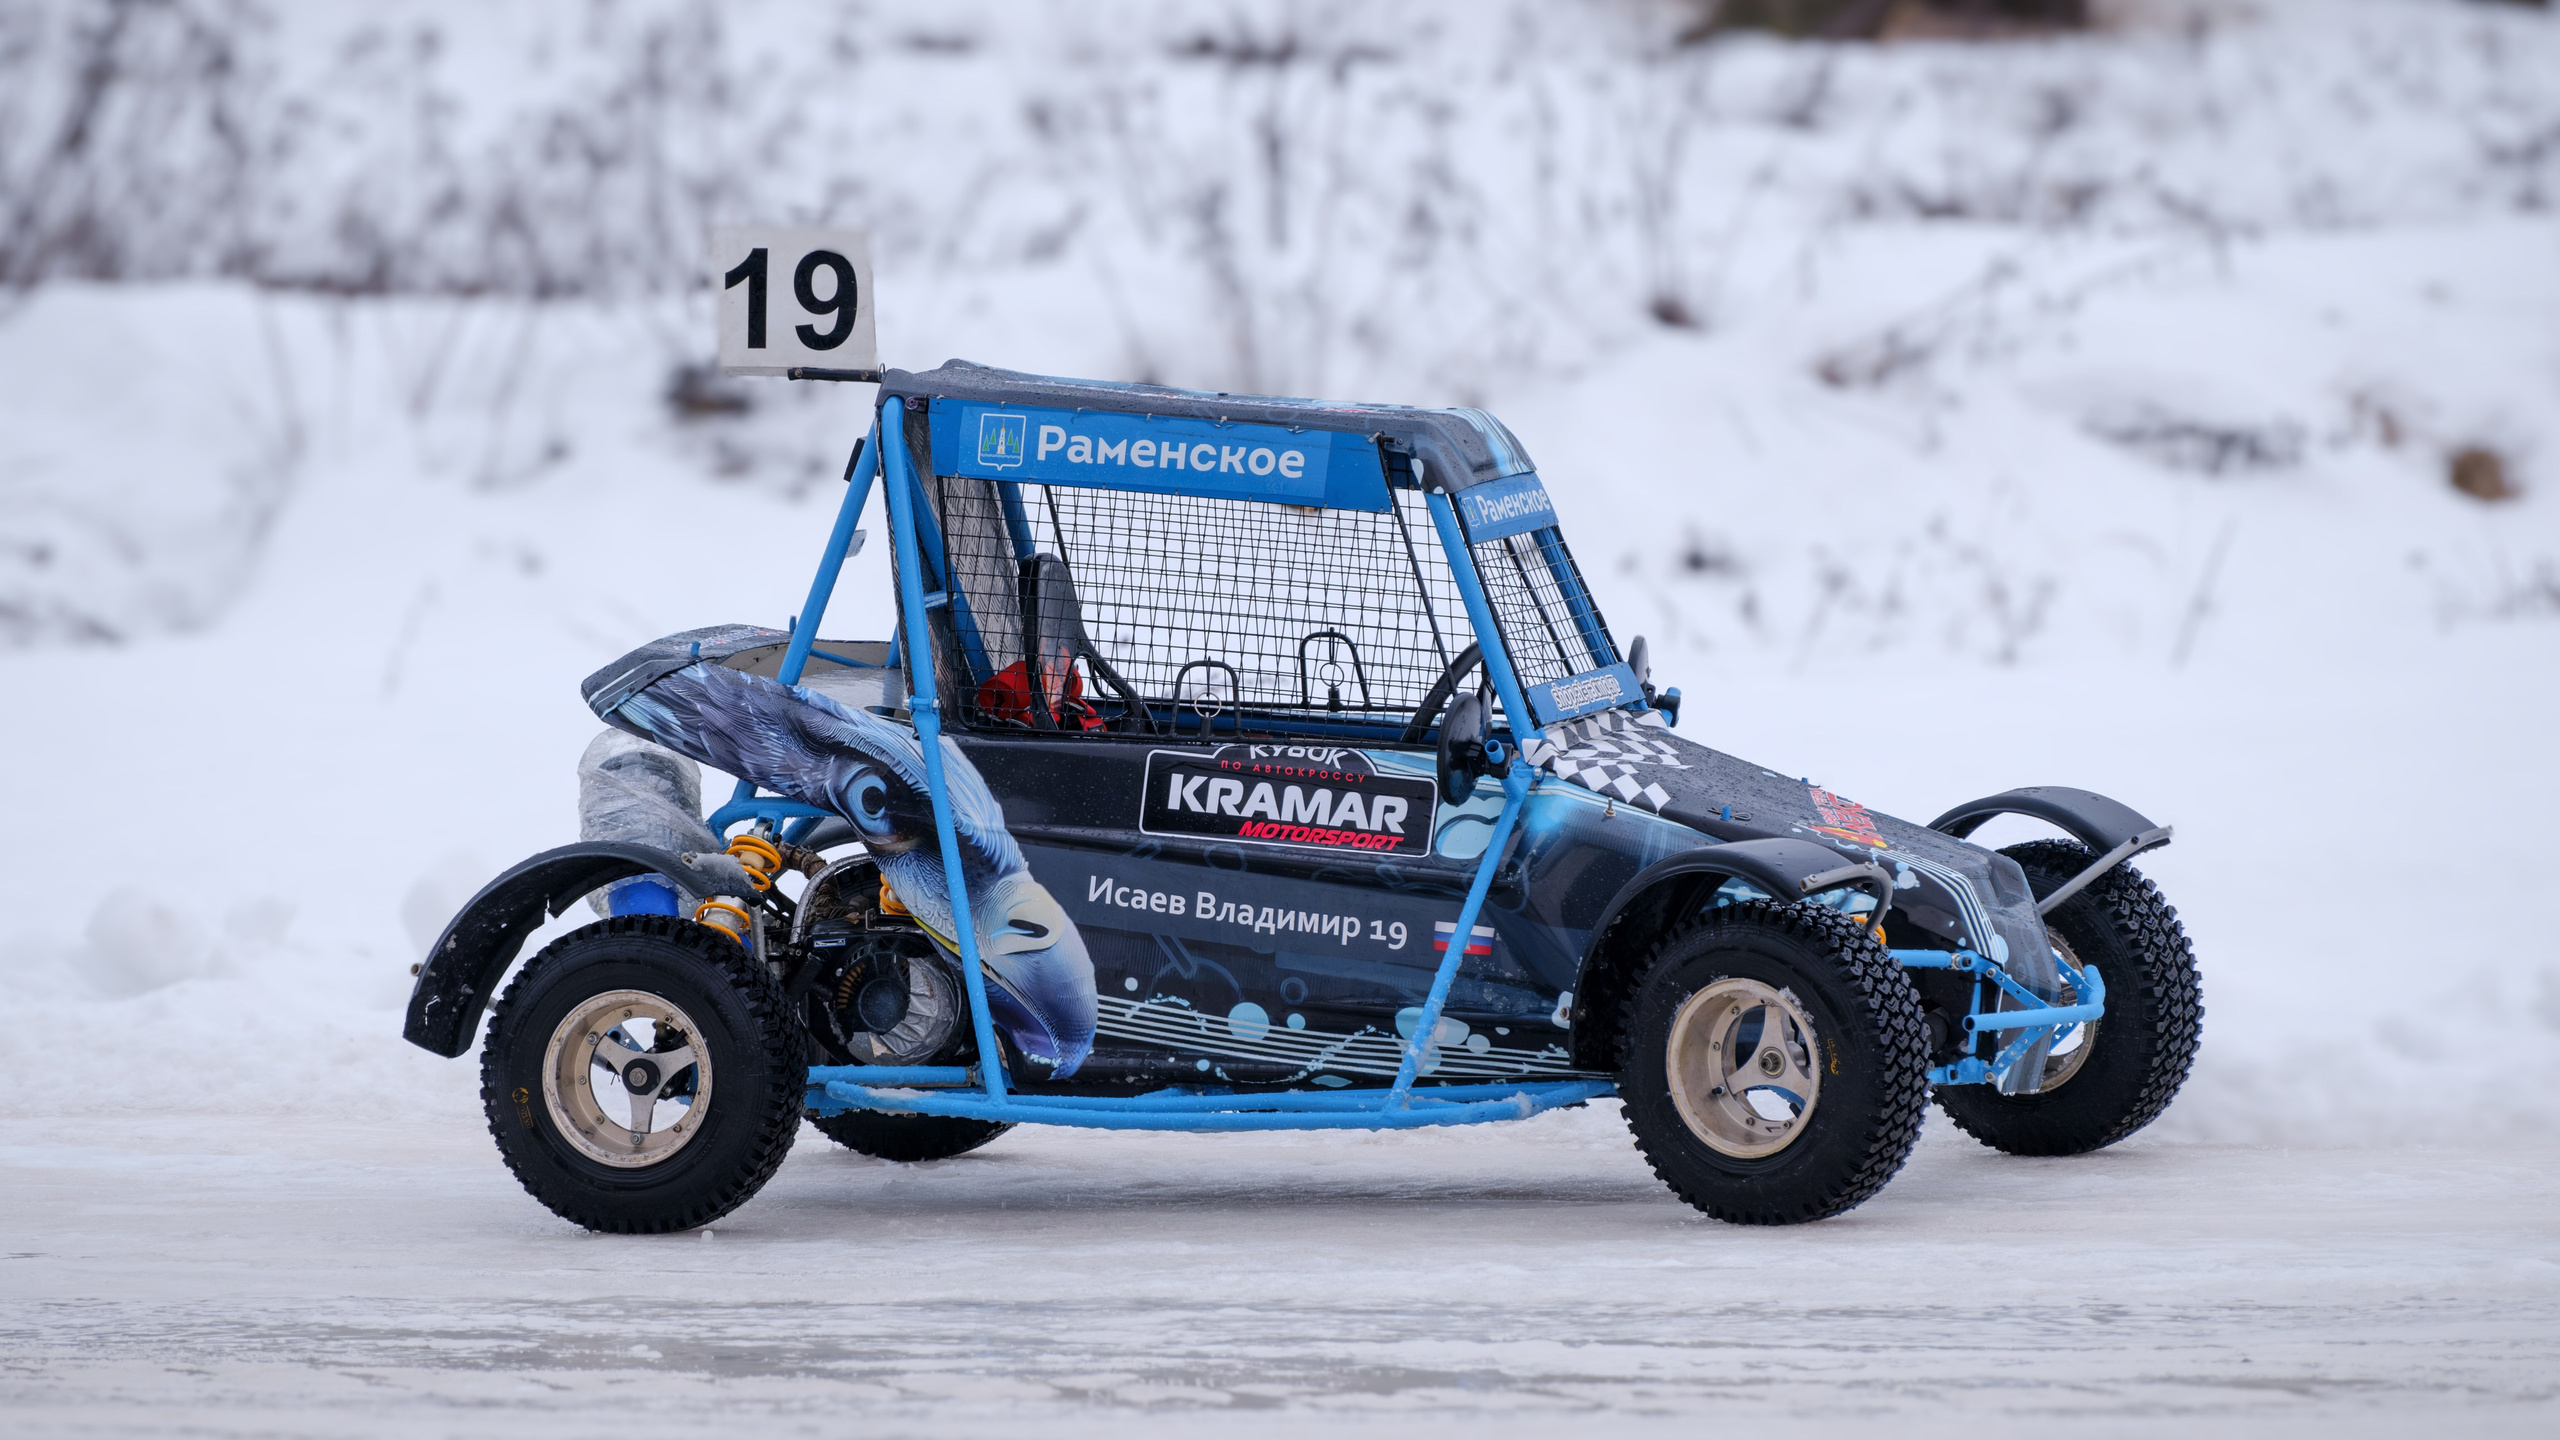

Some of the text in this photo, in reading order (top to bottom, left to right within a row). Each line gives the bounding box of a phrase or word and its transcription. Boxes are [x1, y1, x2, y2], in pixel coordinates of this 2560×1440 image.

[724, 247, 859, 351] 19
[1036, 424, 1306, 479] Раменское
[1475, 487, 1551, 524] Раменское
[1220, 759, 1366, 783] ПО АВТОКРОССУ
[1167, 773, 1409, 834] KRAMAR
[1238, 820, 1404, 851] MOTORSPORT
[1088, 875, 1408, 950] Исаев Владимир 19
